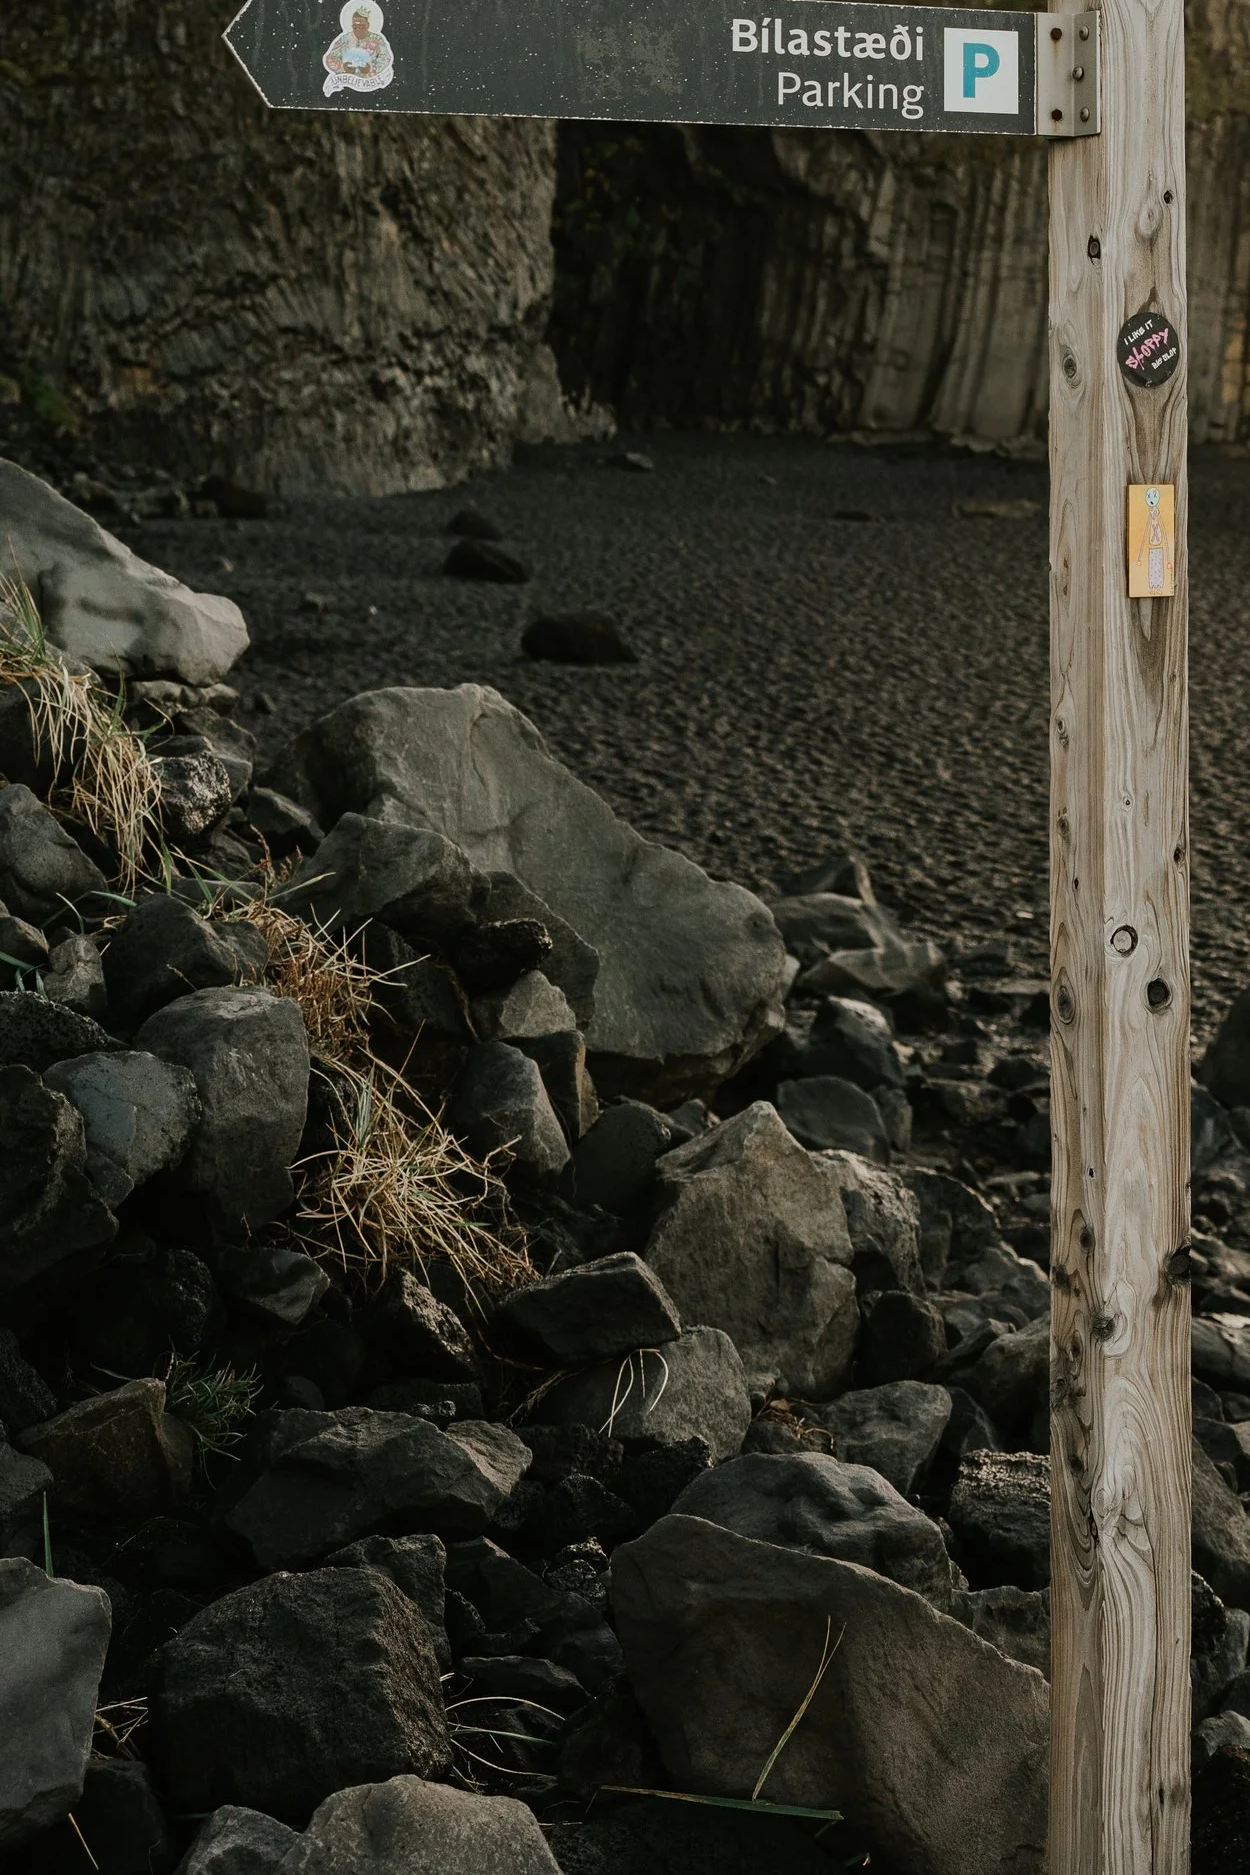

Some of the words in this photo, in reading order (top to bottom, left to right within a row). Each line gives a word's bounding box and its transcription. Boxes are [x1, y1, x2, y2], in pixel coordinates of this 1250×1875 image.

[730, 17, 924, 61] Bílastæði
[331, 74, 384, 88] UNBELIEVABLE
[962, 42, 1000, 99] P
[778, 71, 925, 120] Parking
[1123, 337, 1129, 345] I
[1127, 326, 1146, 343] LIKE
[1144, 319, 1153, 330] IT
[1125, 328, 1169, 370] SLOPPY
